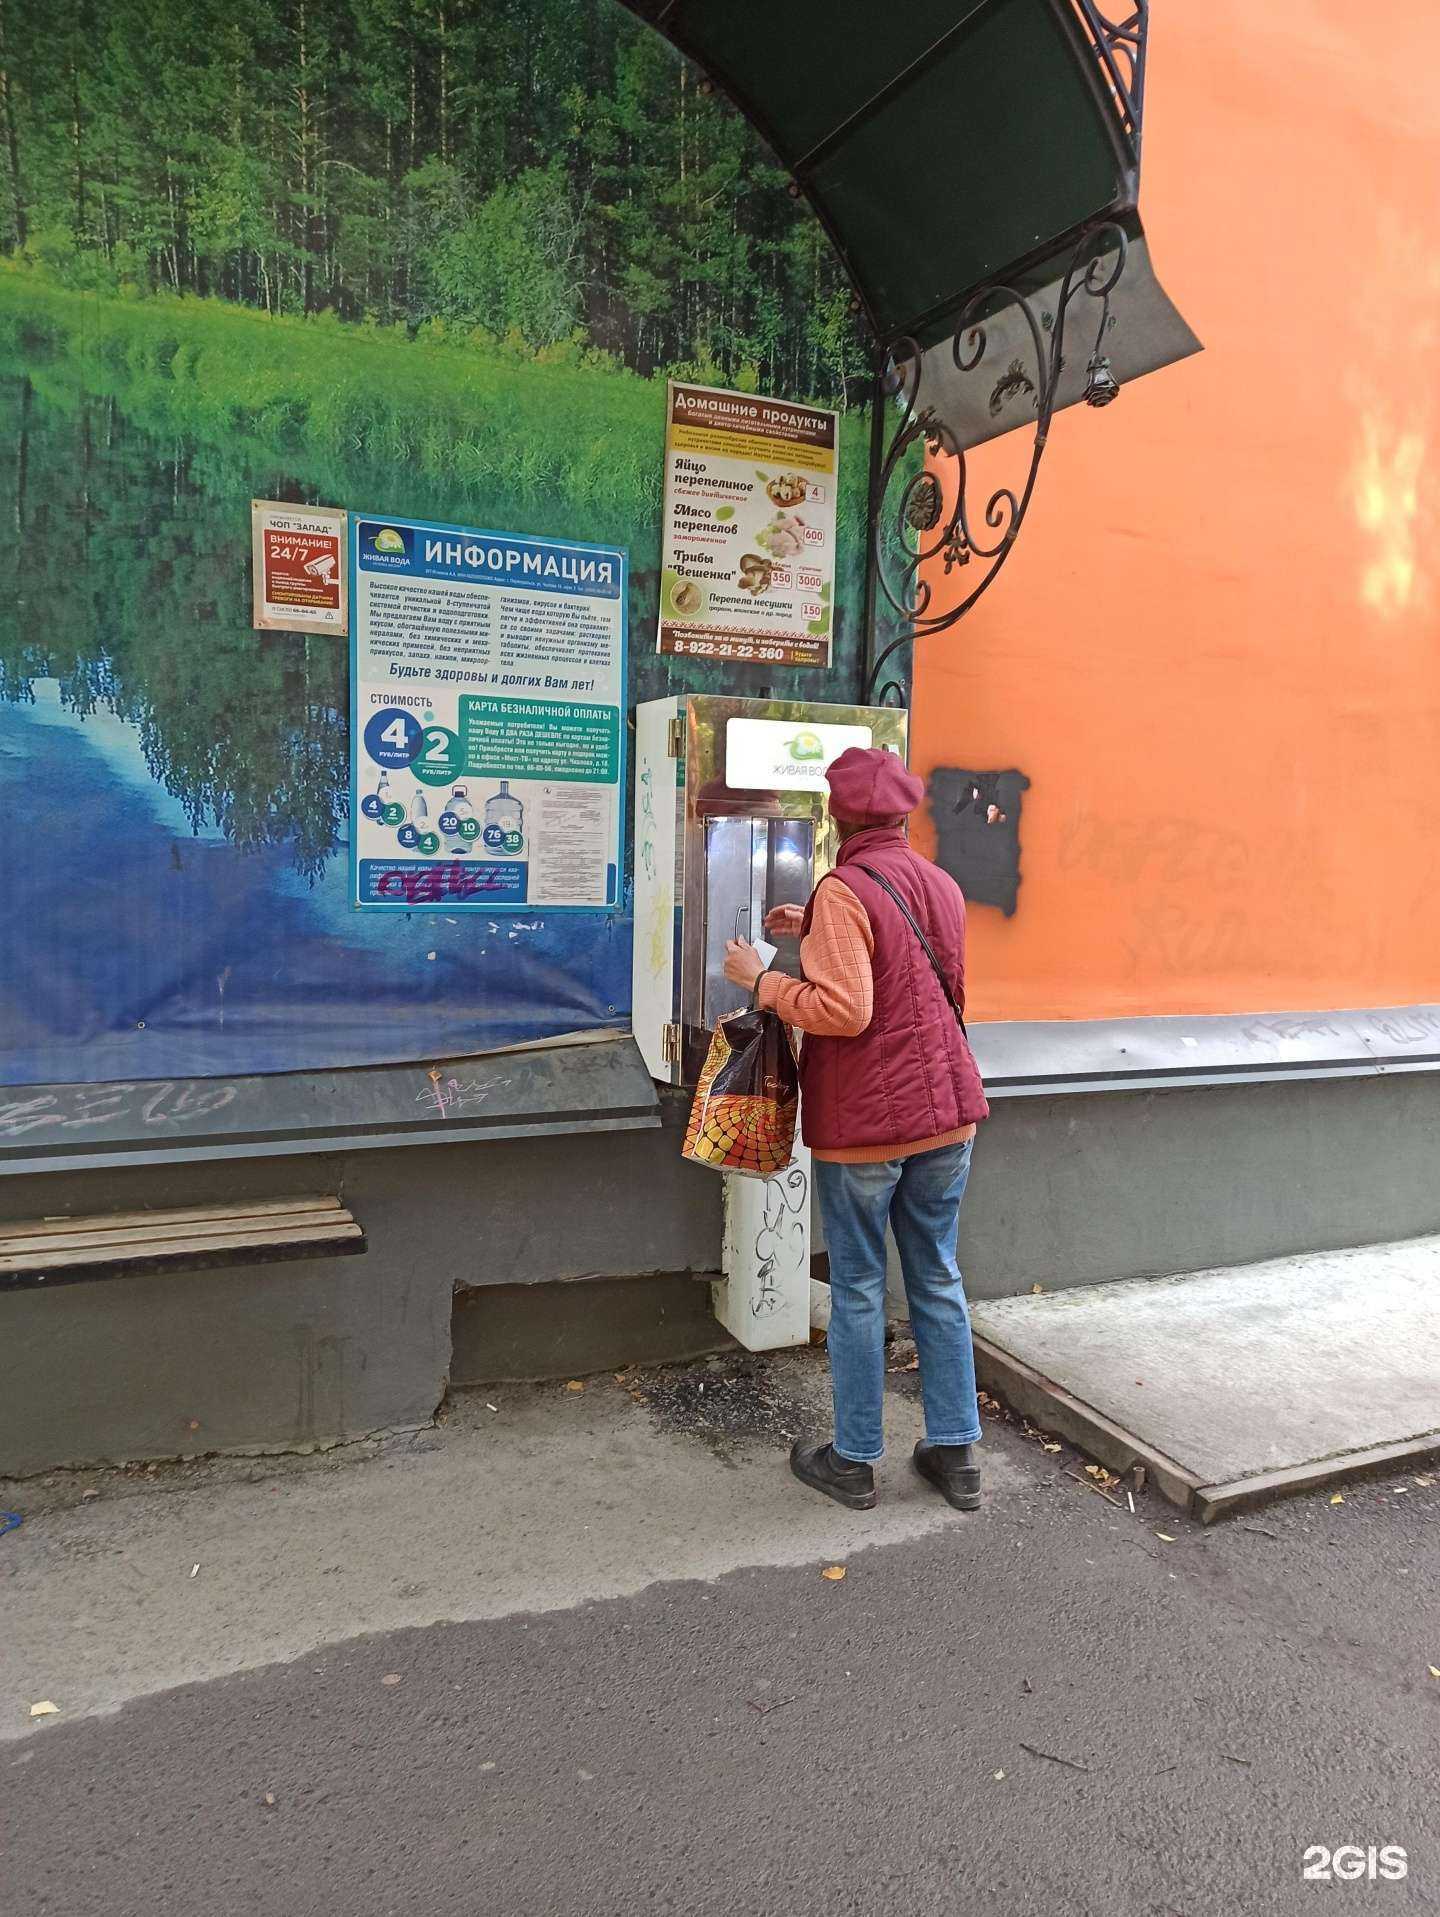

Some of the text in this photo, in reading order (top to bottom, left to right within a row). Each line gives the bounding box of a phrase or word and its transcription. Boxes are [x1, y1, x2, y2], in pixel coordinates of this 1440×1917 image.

[675, 393, 827, 430] Домашние продукты
[675, 458, 706, 474] Яйцо
[675, 475, 754, 492] перепелиное
[674, 488, 700, 496] свежее
[674, 504, 712, 518] Мясо
[270, 520, 332, 534] ЧОП "ЗАПАД"
[674, 520, 738, 535] перепелов
[270, 534, 332, 548] ВНИМАНИЕ!
[674, 534, 727, 544] замороженное
[806, 531, 823, 542] 600
[270, 546, 308, 560] 24/7
[363, 553, 389, 562] ЖИВАЯ
[390, 556, 410, 566] ВОДА
[674, 550, 714, 564] Грибы
[425, 540, 612, 584] ИНФОРМАЦИЯ
[668, 564, 736, 581] "Вешенка"
[772, 572, 790, 583] 350
[798, 576, 822, 588] 3000
[428, 588, 448, 596] нашей
[709, 593, 793, 610] Перепела несушки
[370, 610, 382, 618] Мы
[546, 611, 570, 619] которую
[803, 604, 820, 616] 150
[408, 632, 420, 640] без
[672, 630, 714, 640] Позвоните
[762, 639, 794, 648] заберите
[674, 640, 784, 660] 8-922-21-22-360
[390, 662, 594, 690] Будьте здоровы и долгих Вам лет!
[370, 694, 432, 708] СТОИМОСТЬ
[468, 701, 611, 720] КАРТА БЕЗНАЛИЧНОЙ ОПЛАТЫ
[380, 718, 408, 749] 4
[426, 732, 450, 762] 2
[774, 765, 808, 776] ЖИВАЯ
[370, 800, 378, 809] 4
[390, 808, 396, 816] 2
[442, 818, 458, 826] 20
[464, 822, 476, 832] 10
[404, 831, 412, 839] 8
[488, 830, 500, 838] 76
[506, 834, 520, 843] 38
[424, 837, 432, 846] 4
